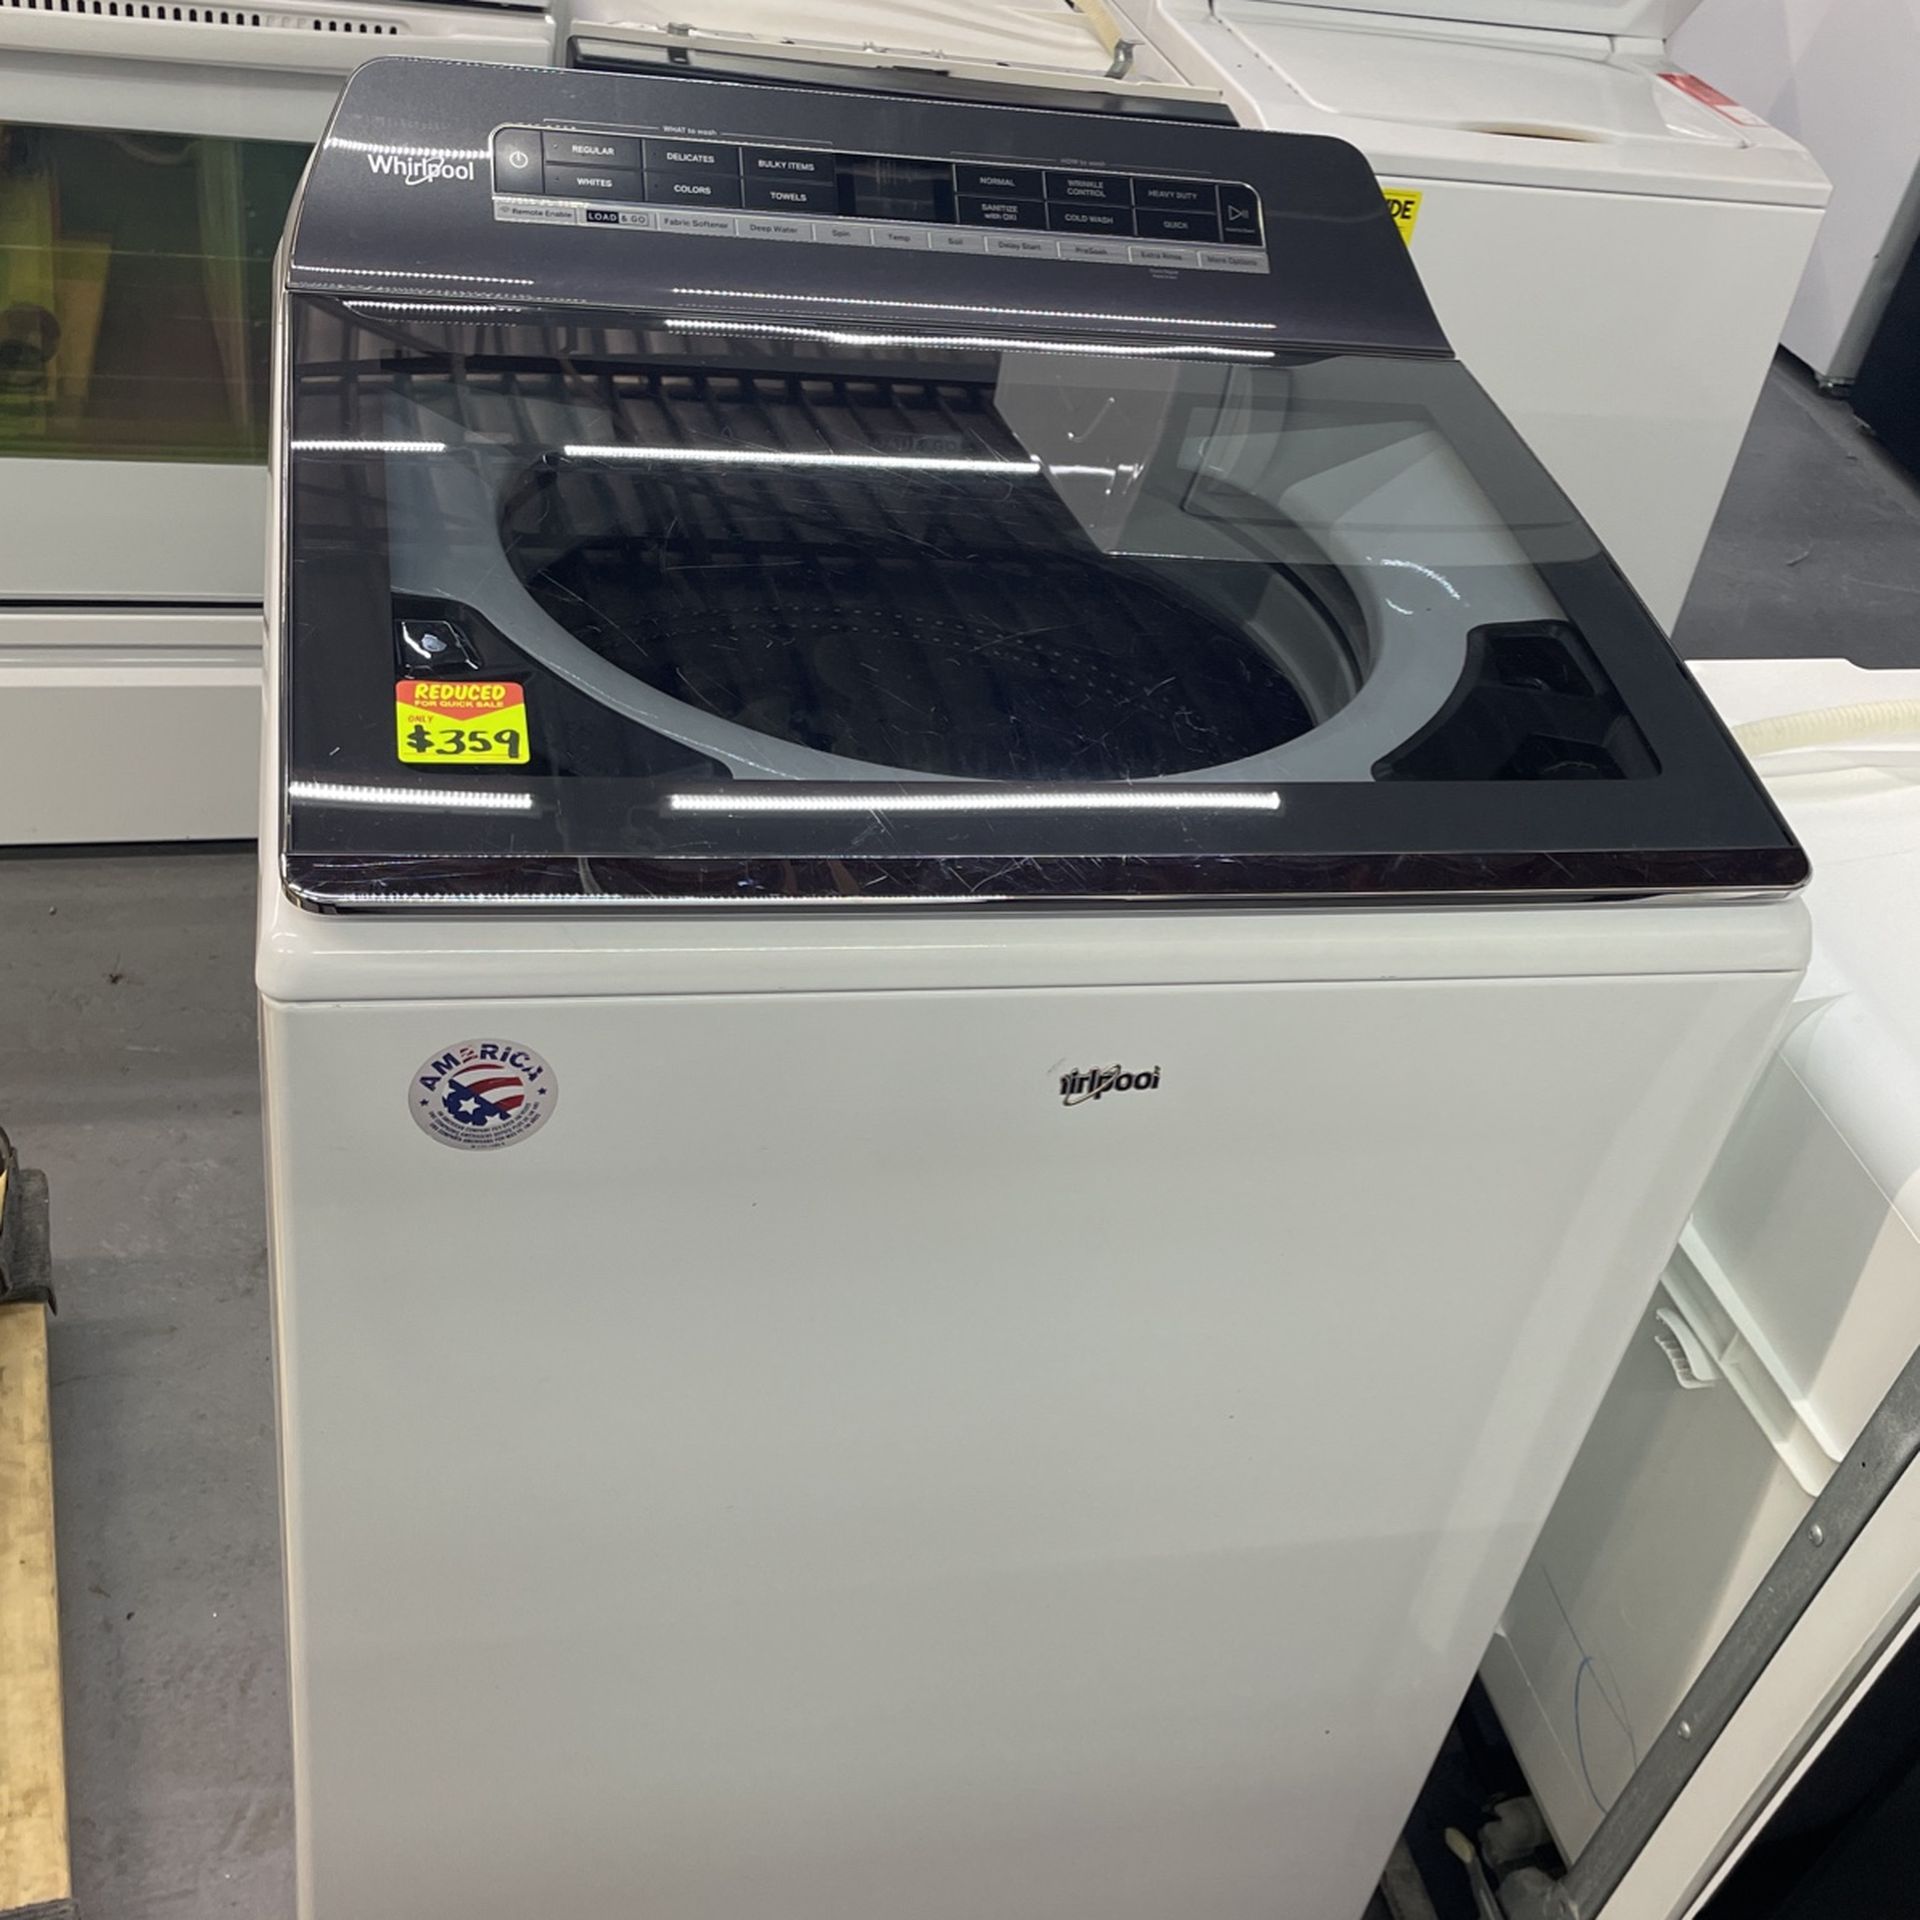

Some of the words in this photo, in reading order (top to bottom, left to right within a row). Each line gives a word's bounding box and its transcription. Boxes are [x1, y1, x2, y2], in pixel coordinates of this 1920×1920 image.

[663, 125, 685, 134] WHAT
[698, 127, 718, 136] wash
[572, 144, 615, 156] REGULAR
[667, 151, 715, 164] DELICATES
[367, 153, 475, 186] Whirlpool
[758, 159, 787, 170] BULKY
[788, 162, 815, 172] ITEMS
[576, 177, 613, 188] WHITES
[979, 176, 1016, 188] NORMAL
[1067, 179, 1104, 189] WRINKLE
[673, 184, 712, 195] COLORS
[1066, 187, 1106, 198] CONTROL
[1147, 189, 1175, 199] HEAVY
[1175, 191, 1198, 200] DUTY
[769, 191, 807, 202] TOWELS
[512, 207, 543, 217] Remote
[544, 209, 573, 218] Enable
[981, 203, 1018, 214] SANITIZE
[588, 212, 618, 223] LOAD
[630, 215, 646, 224] GO
[664, 217, 691, 227] Fabric
[692, 219, 729, 230] Softener
[1064, 213, 1088, 223] COLD
[1089, 214, 1113, 225] WASH
[750, 223, 772, 234] Deep
[774, 226, 798, 235] Water
[1163, 220, 1189, 230] QUICK
[832, 229, 850, 238] Spin
[888, 233, 911, 243] Temp
[998, 240, 1021, 250] Delay
[1022, 242, 1042, 250] Start
[415, 683, 506, 701] REDUCED
[414, 699, 439, 708] FOR
[440, 700, 474, 708] QUICK
[408, 714, 434, 724] ONLY
[406, 724, 521, 759] $359
